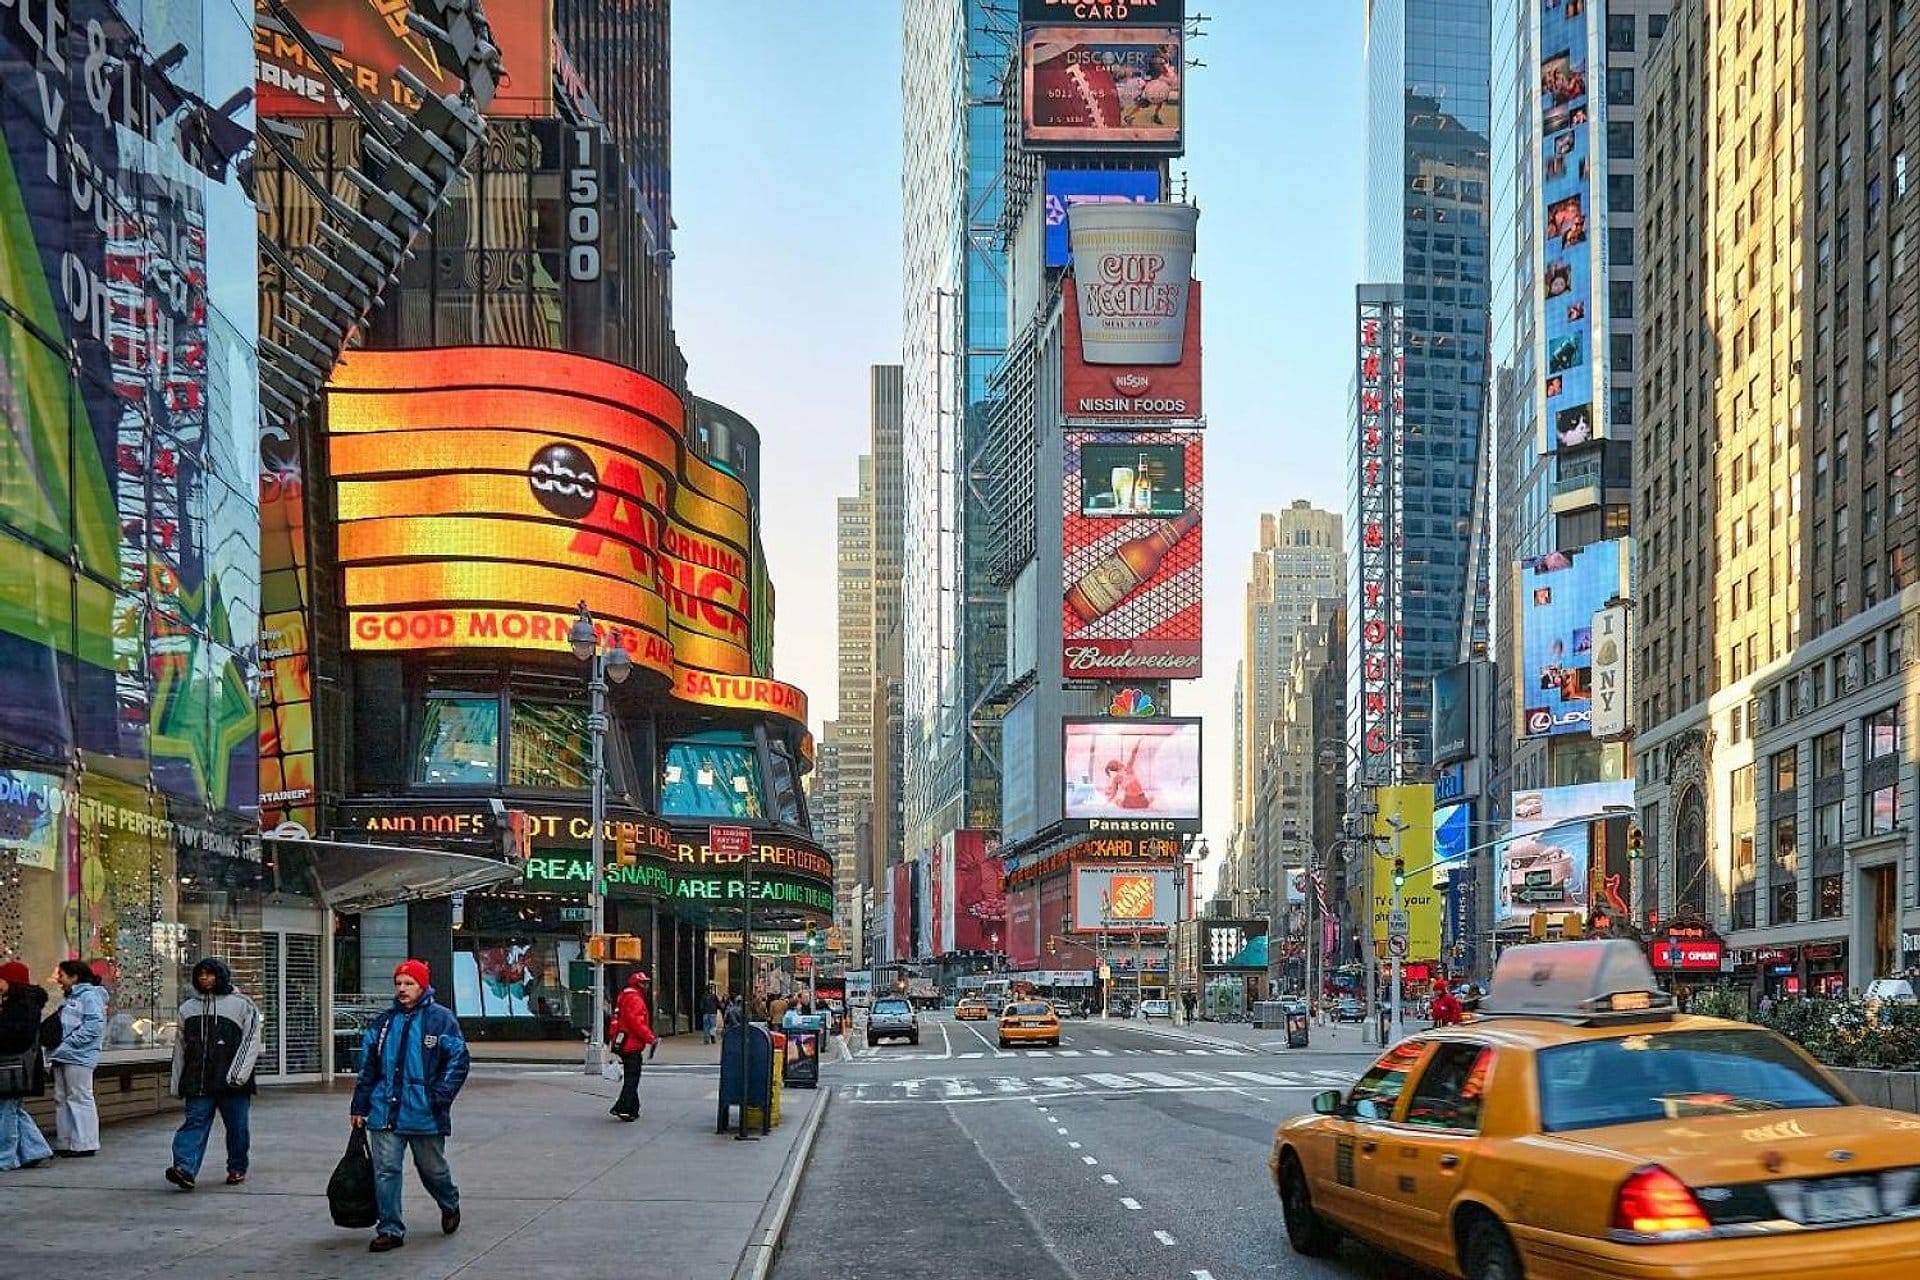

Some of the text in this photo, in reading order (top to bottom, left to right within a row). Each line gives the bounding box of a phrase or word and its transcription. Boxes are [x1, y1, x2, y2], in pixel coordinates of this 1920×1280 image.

[1073, 4, 1128, 19] CARD
[1066, 51, 1145, 65] DISCOVER
[255, 59, 325, 104] AME
[568, 129, 600, 281] 1500
[1097, 253, 1165, 286] CUP
[1083, 282, 1180, 317] NOODLES
[1115, 375, 1149, 388] NISSIN
[1080, 399, 1186, 412] NISSIN FOODS
[530, 458, 595, 499] abc
[663, 525, 743, 579] ORNING
[355, 611, 456, 643] GOOD
[468, 611, 638, 654] MORNG
[1064, 646, 1200, 670] Budweiser
[88, 799, 115, 828] THE
[120, 807, 174, 841] PERFECT
[527, 815, 563, 838] OT
[1089, 818, 1175, 831] Panasonic
[526, 856, 595, 881] REAK
[676, 879, 722, 899] ARE
[1404, 896, 1431, 907] your
